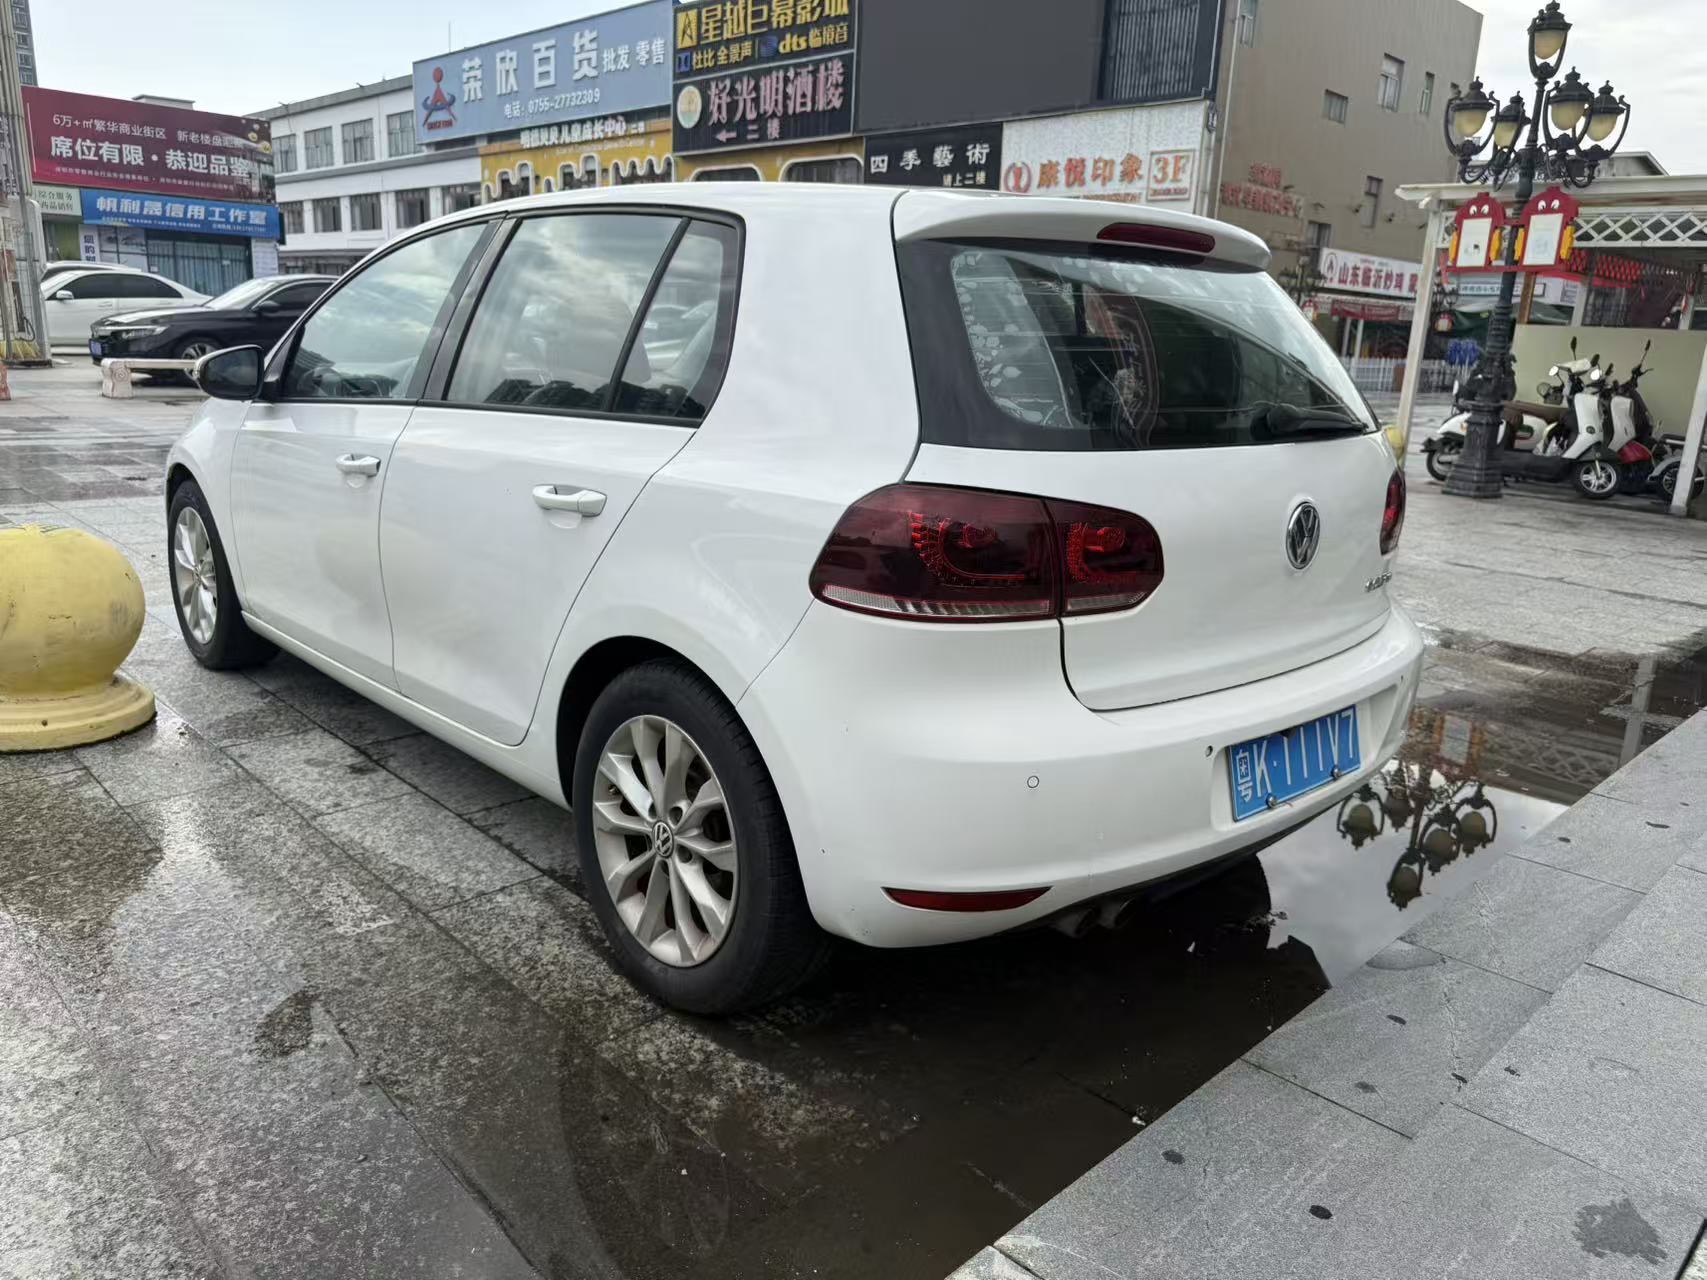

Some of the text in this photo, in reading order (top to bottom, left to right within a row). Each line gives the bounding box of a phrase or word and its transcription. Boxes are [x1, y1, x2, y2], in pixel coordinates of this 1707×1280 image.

[462, 29, 665, 103] 荣欣百货 批发 零售
[708, 58, 845, 126] 好光明酒楼
[747, 118, 780, 139] 二楼
[1153, 154, 1190, 184] 3F
